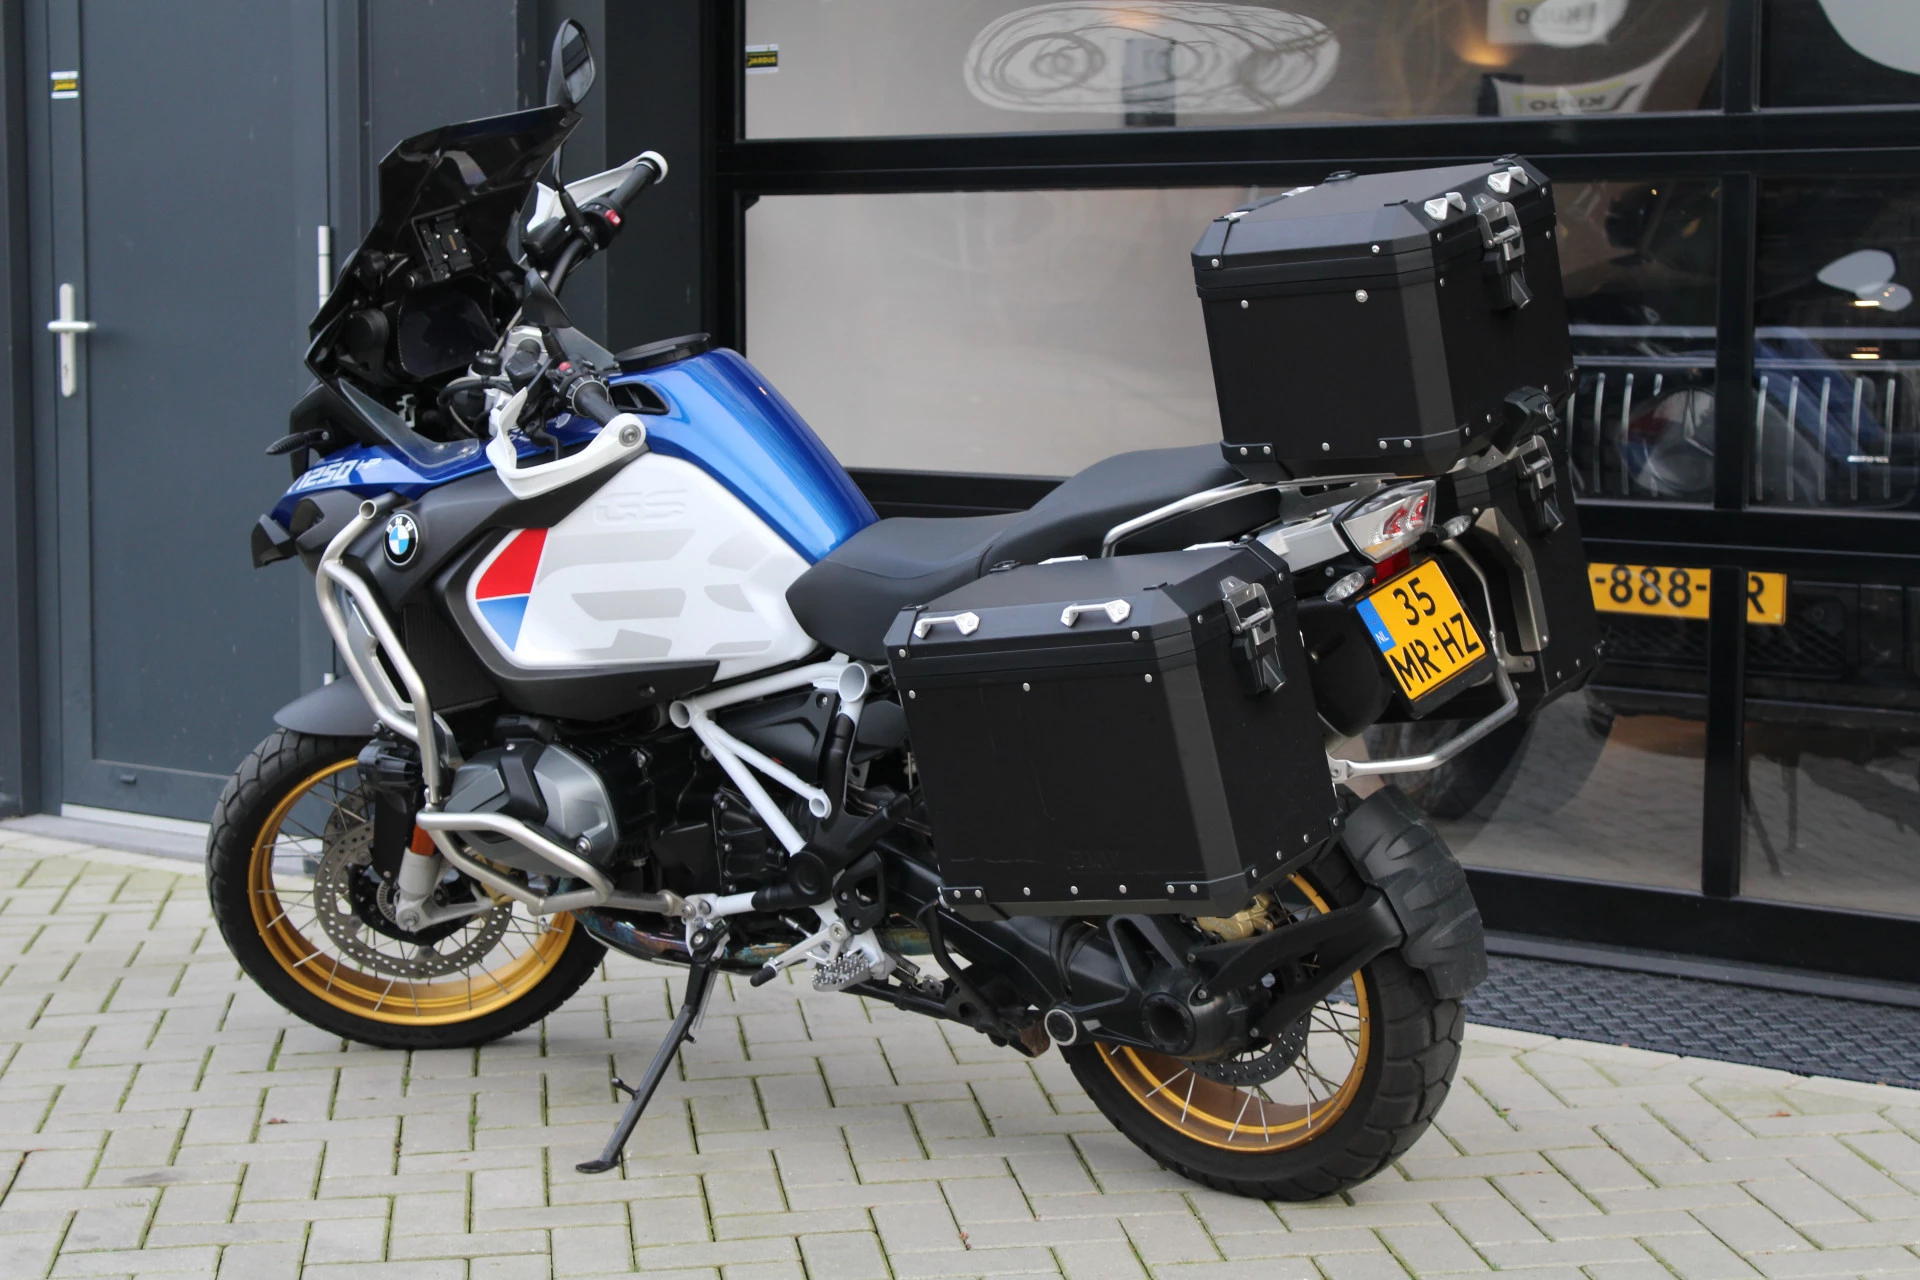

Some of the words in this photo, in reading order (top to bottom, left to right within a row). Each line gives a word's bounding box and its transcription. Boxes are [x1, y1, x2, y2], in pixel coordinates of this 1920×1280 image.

[296, 459, 359, 490] 1250
[386, 516, 414, 534] BMW
[1392, 576, 1436, 626] 35
[1374, 630, 1390, 645] NL
